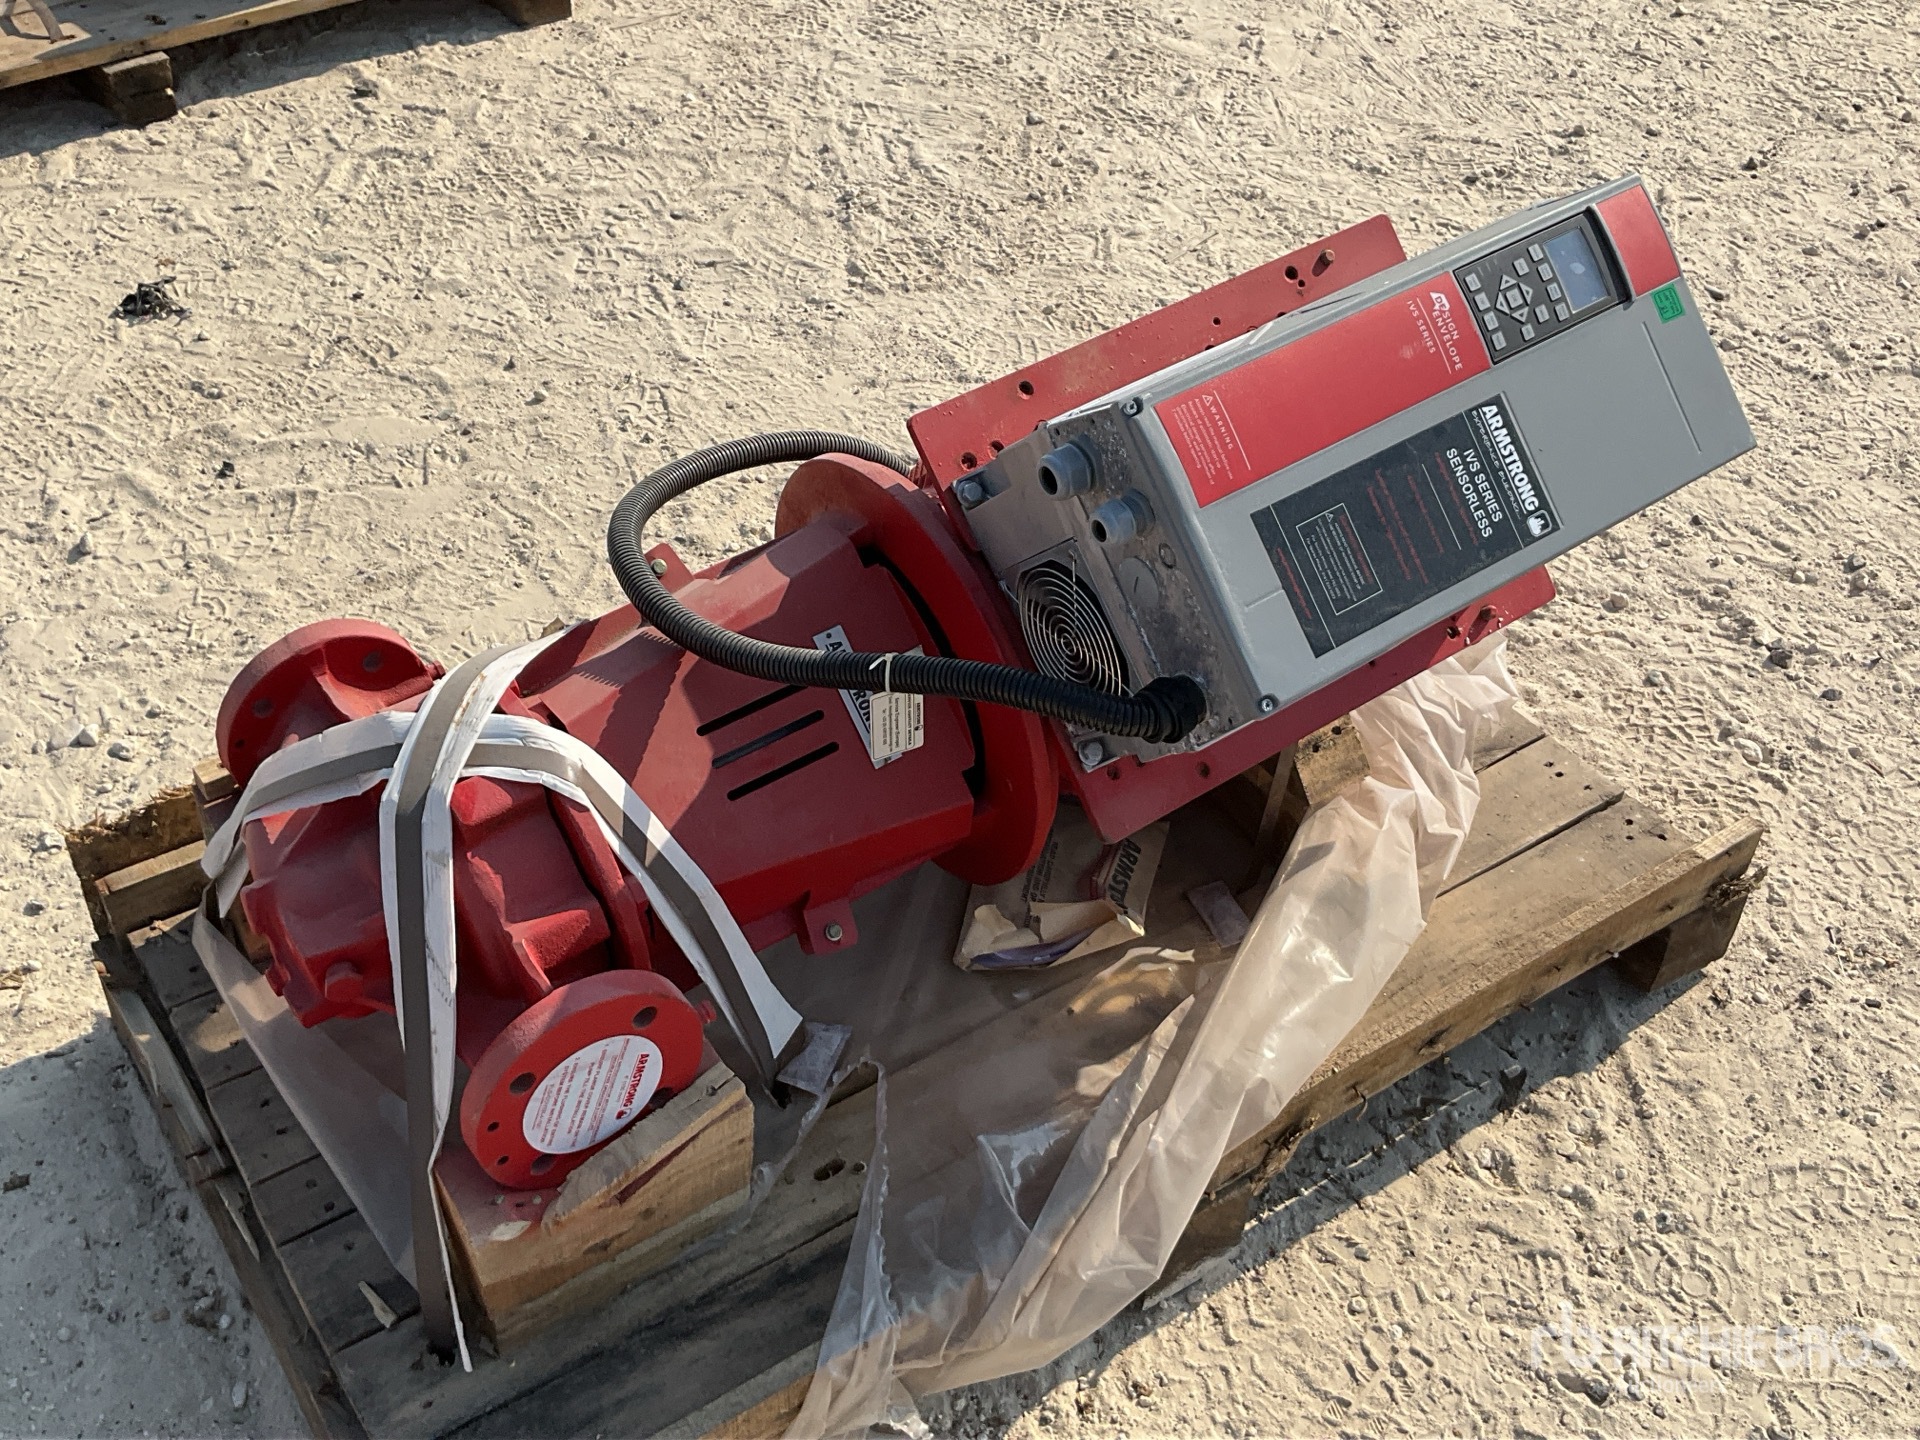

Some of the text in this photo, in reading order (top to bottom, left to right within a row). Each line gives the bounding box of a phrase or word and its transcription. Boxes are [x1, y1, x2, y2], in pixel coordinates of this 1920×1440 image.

[1406, 300, 1436, 353] IVS SERIES
[1431, 310, 1463, 370] ENVELOPE
[1434, 295, 1460, 339] DESIGN
[1209, 405, 1234, 449] WARNING
[1470, 410, 1500, 468] EXPERIENCE
[1462, 449, 1503, 522] IVS SERIES
[1481, 405, 1539, 512] ARMSTRONG
[1444, 447, 1493, 537] SENSORLESS
[622, 1052, 649, 1107] ARMSTRONG
